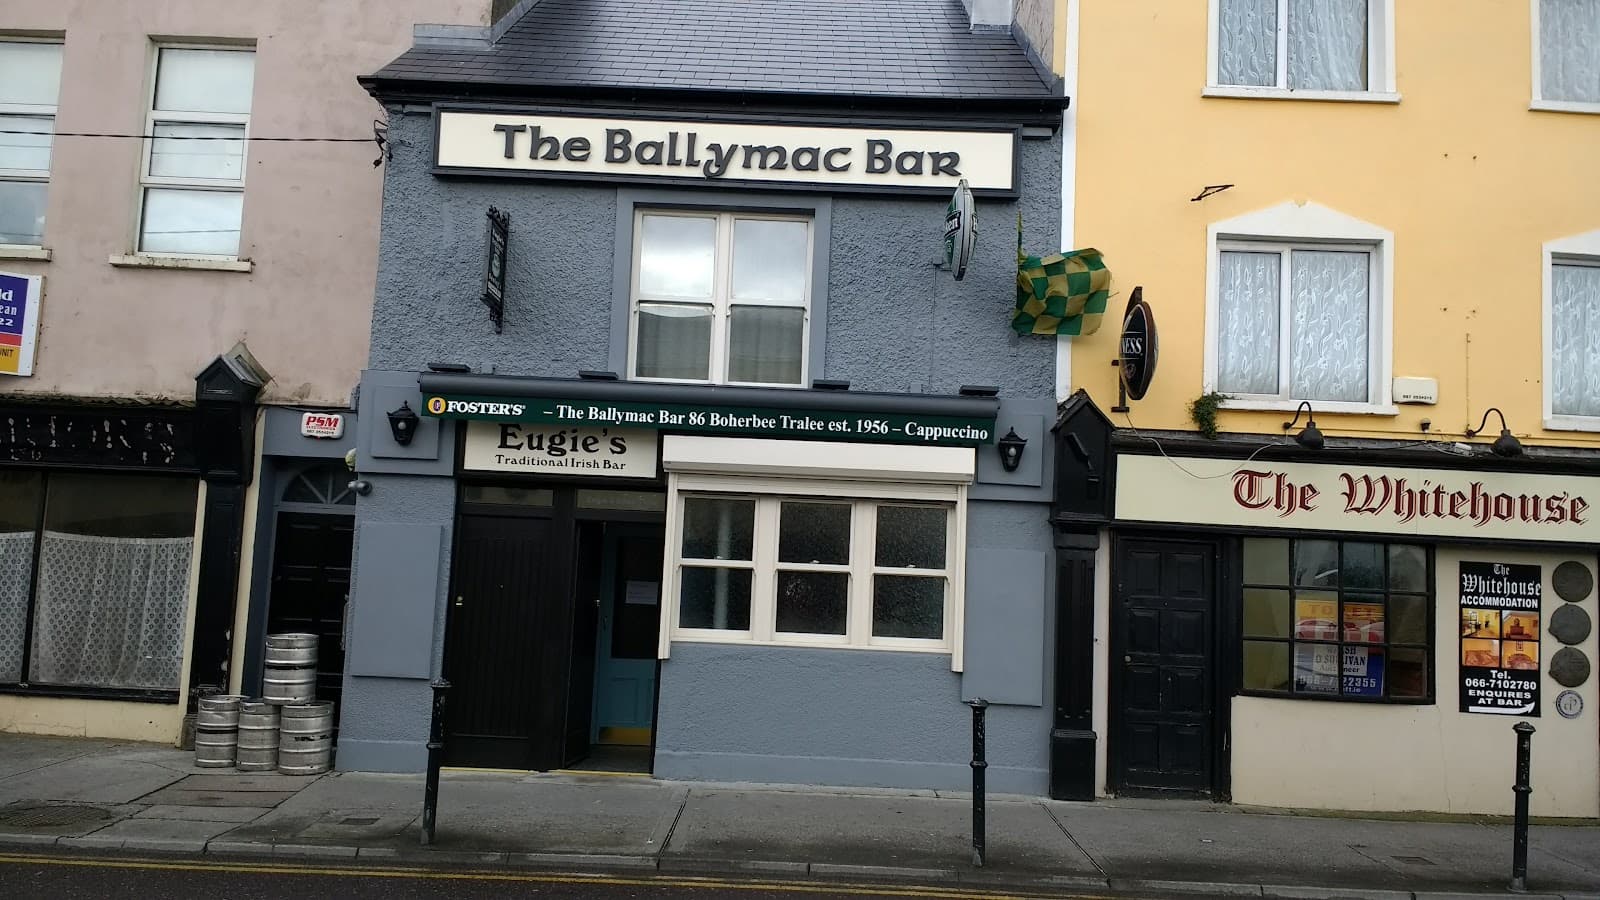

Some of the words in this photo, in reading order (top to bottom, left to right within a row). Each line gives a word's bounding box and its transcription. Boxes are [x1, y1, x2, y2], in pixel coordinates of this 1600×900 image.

[493, 123, 591, 162] The
[604, 128, 852, 179] Ballymac
[865, 139, 963, 177] Bar
[306, 416, 339, 428] PSM
[446, 400, 523, 416] FOSTER'S
[556, 404, 584, 419] The
[588, 406, 655, 425] Ballymac
[658, 410, 686, 425] Bar
[688, 411, 706, 426] 86
[709, 412, 777, 429] Boherbee
[780, 415, 825, 431] Tralee
[828, 420, 852, 433] est.
[856, 419, 889, 435] 1956
[904, 422, 988, 441] Cappuccino
[497, 423, 627, 457] Eugie's
[494, 454, 568, 467] Traditional
[570, 458, 600, 469] Irish
[603, 459, 627, 470] Bar
[1232, 469, 1320, 518] The
[1339, 472, 1590, 528] Whitehouse
[1493, 563, 1510, 576] The
[1461, 573, 1541, 597] Whitehouse
[1460, 595, 1539, 608] ACCOMMODATION
[1490, 670, 1511, 680] Tel.
[1465, 678, 1537, 690] 066-7102780
[1468, 689, 1532, 699] ENQUIRES
[1477, 697, 1494, 705] AT
[1497, 698, 1522, 706] BAR
